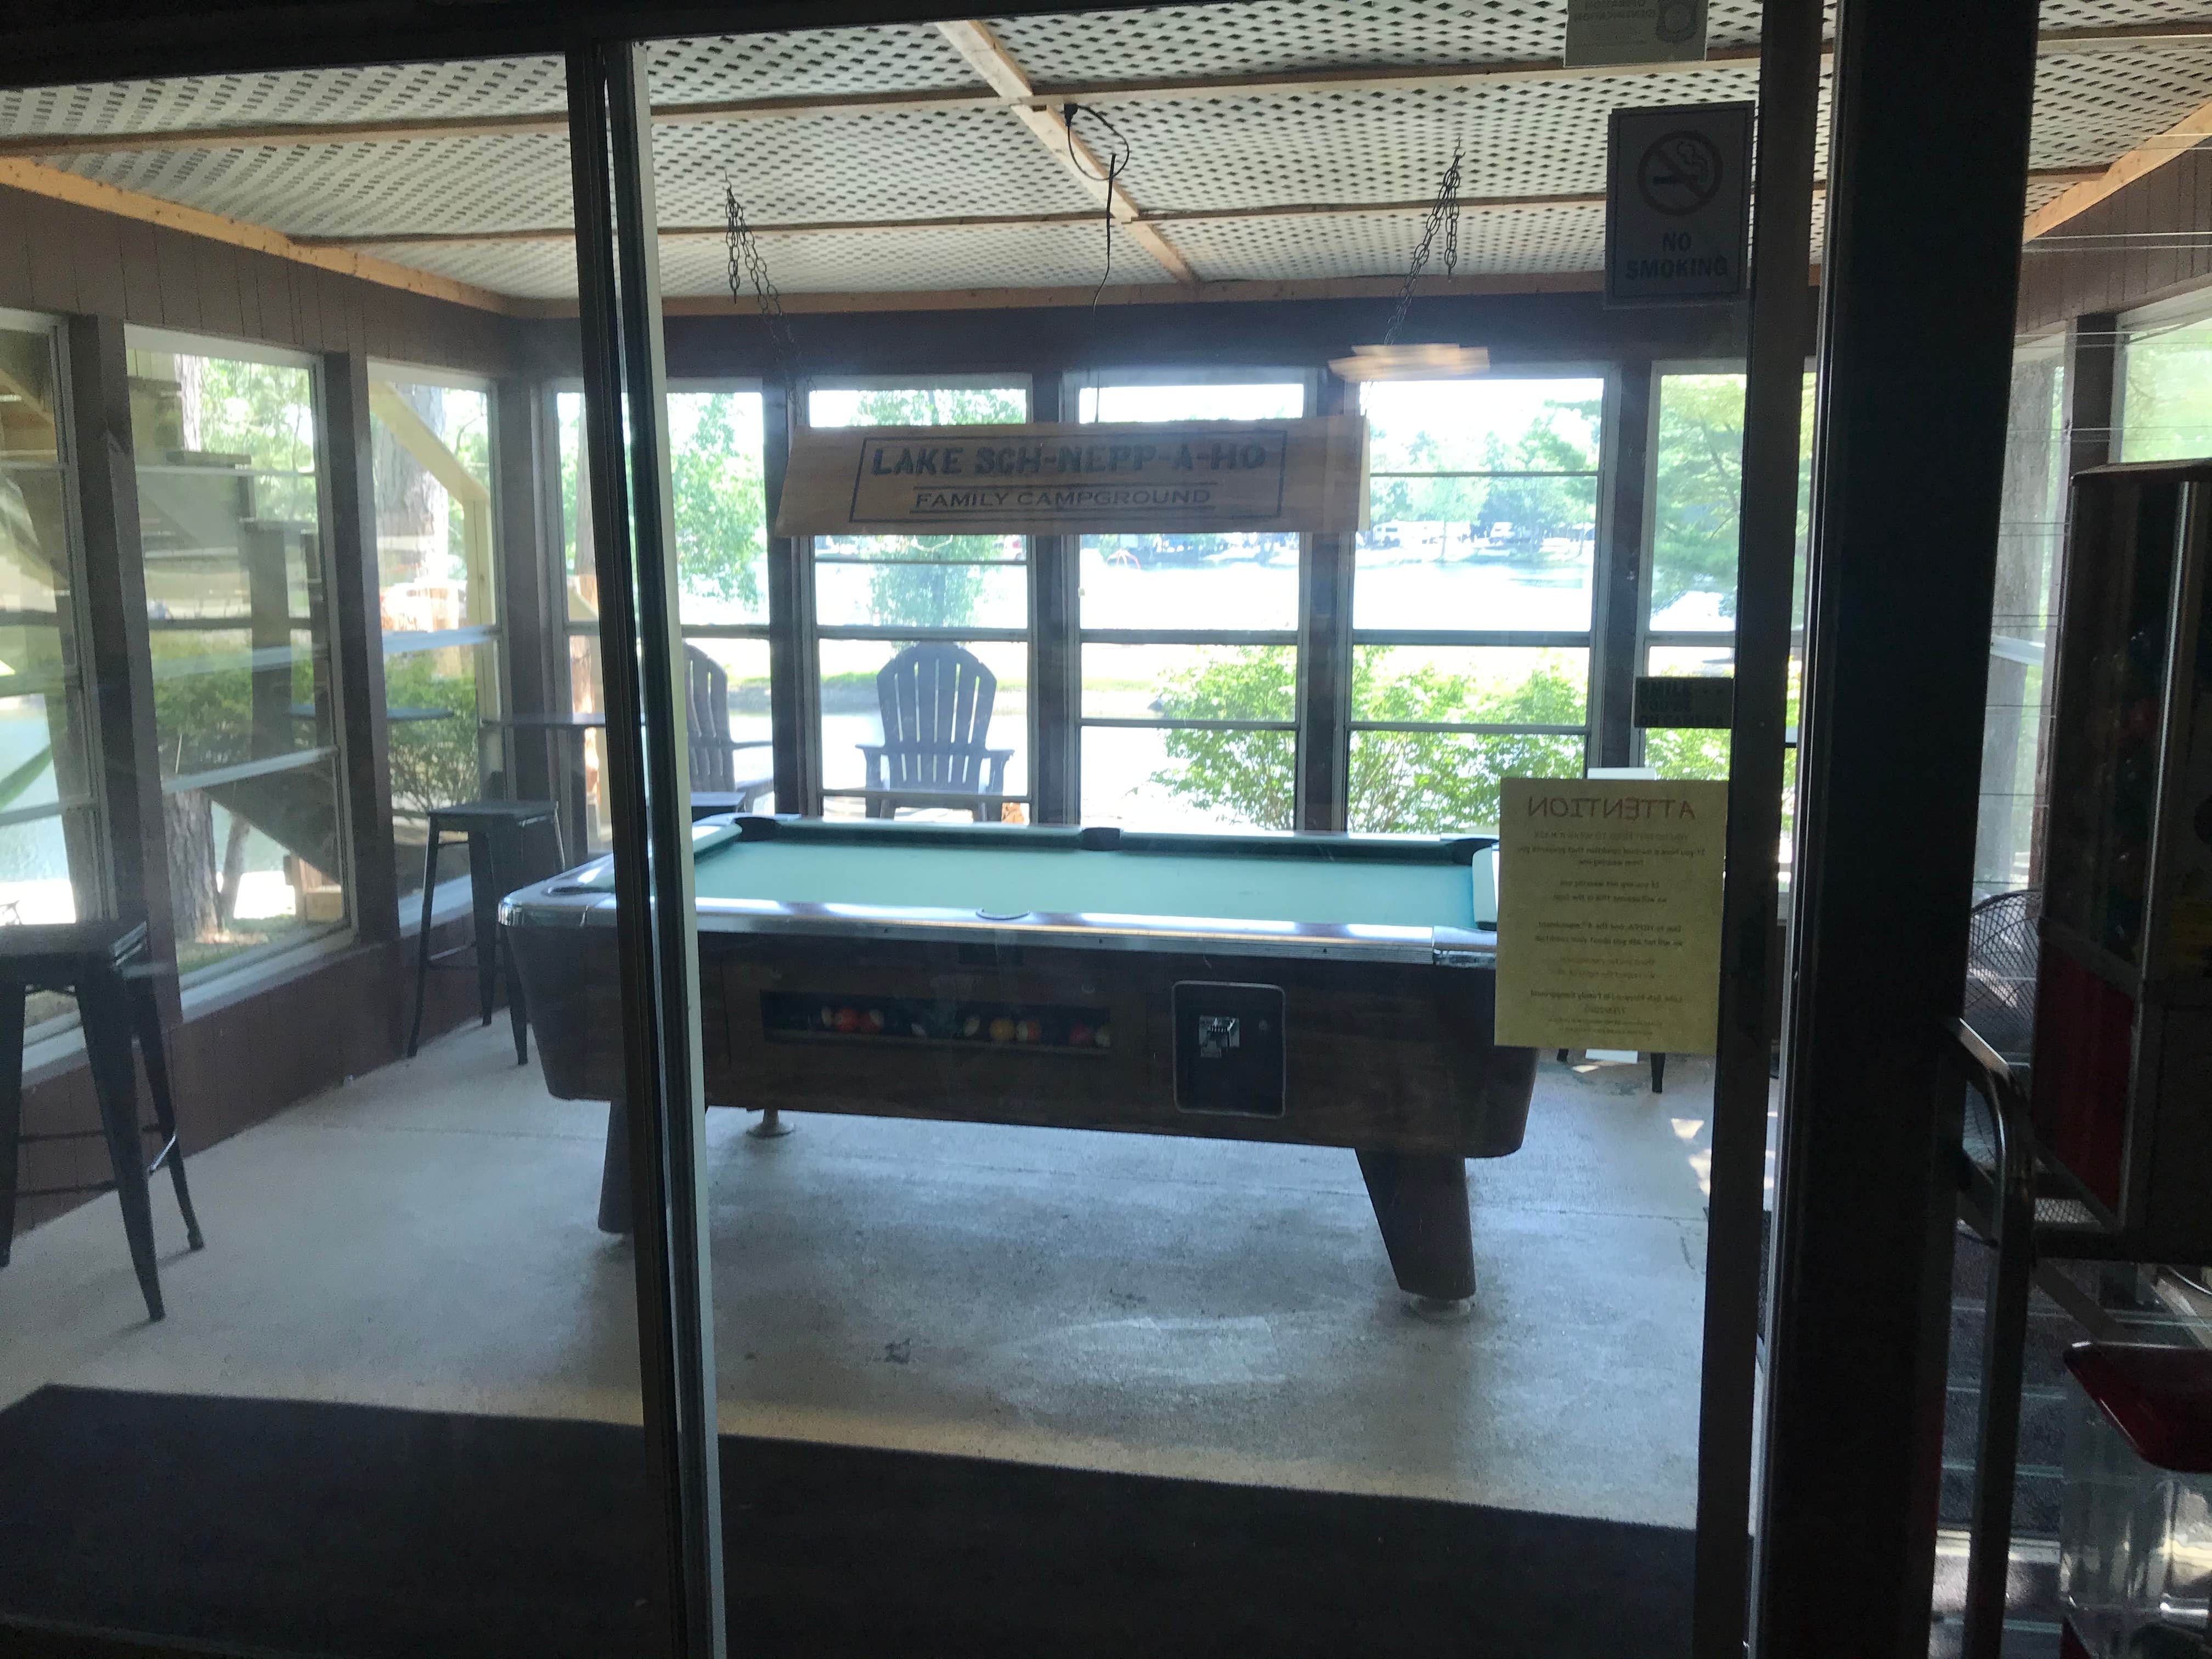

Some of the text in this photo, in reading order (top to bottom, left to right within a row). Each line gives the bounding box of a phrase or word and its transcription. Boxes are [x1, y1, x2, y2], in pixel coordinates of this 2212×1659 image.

[1663, 230, 1692, 252] NO
[1626, 256, 1728, 280] SMOKING
[871, 447, 964, 475] LAKE
[915, 489, 1211, 507] FAMILY CAMPGROUND
